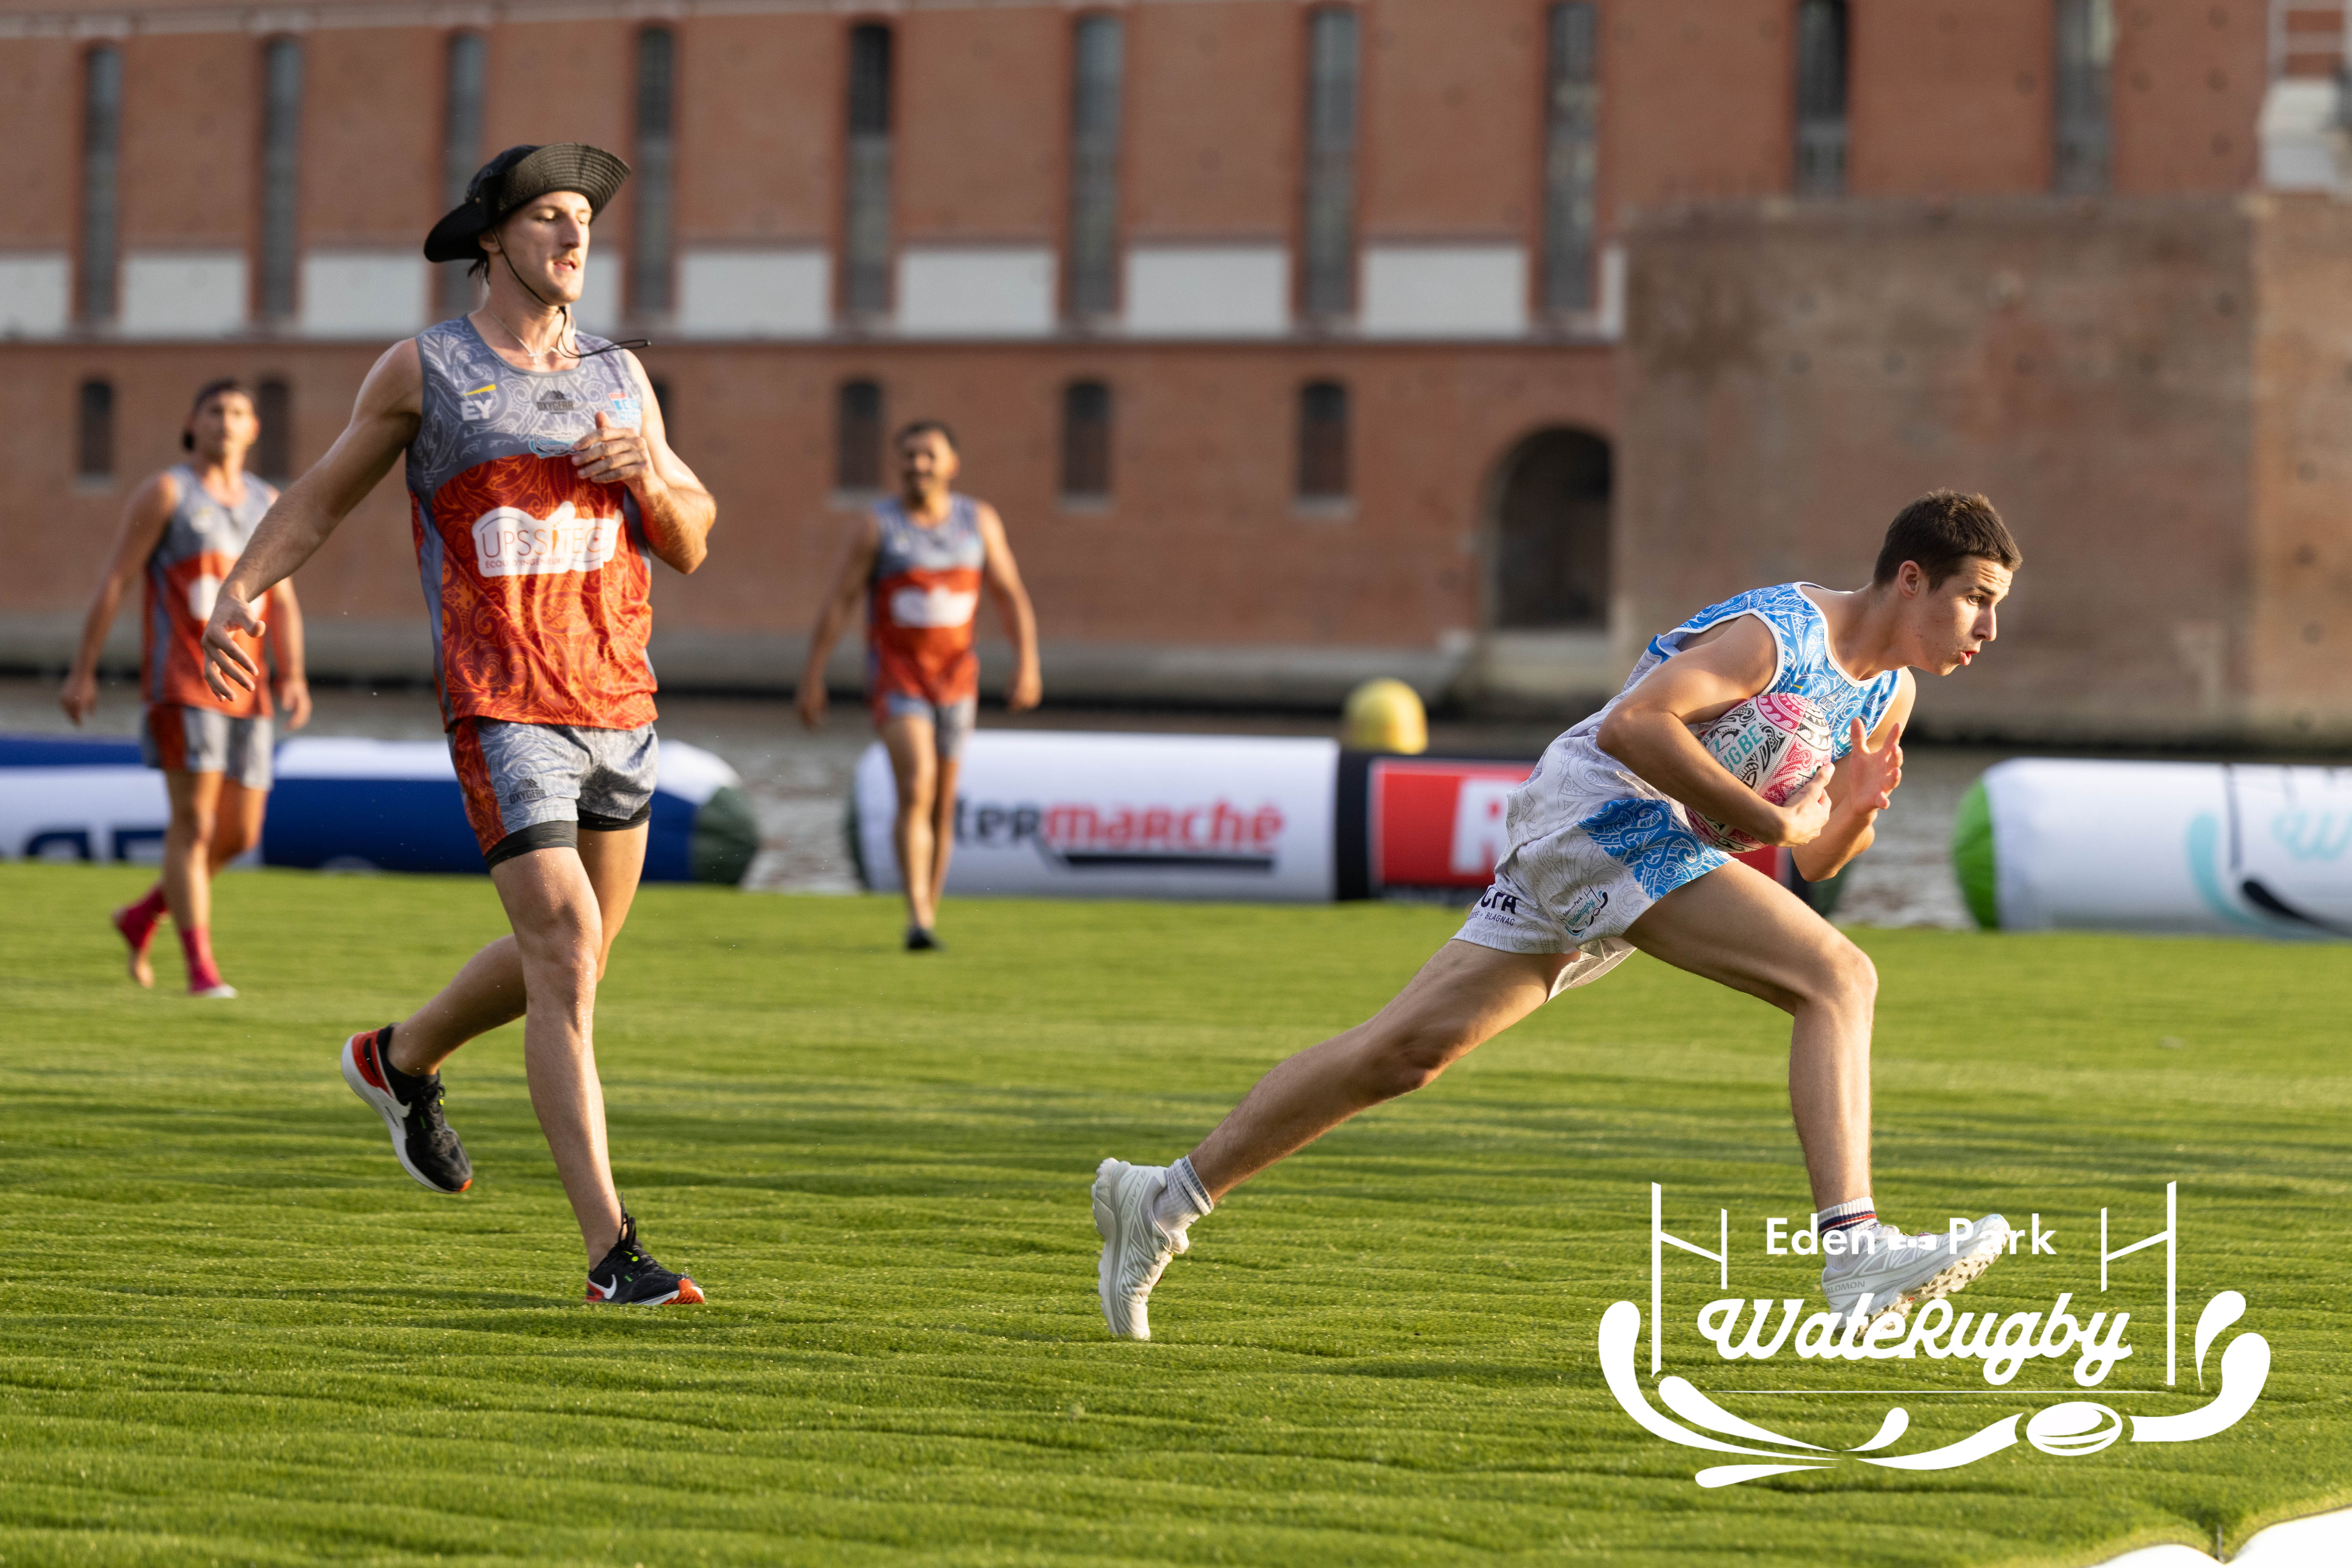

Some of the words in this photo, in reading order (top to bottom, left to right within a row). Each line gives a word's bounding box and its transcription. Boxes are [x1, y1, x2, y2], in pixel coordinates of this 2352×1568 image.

[461, 399, 493, 421] EY
[510, 789, 546, 804] OXYGEAR
[1573, 896, 1583, 906] Park
[1485, 912, 1515, 926] BLAGNAC
[1824, 1281, 1865, 1295] SALOMON
